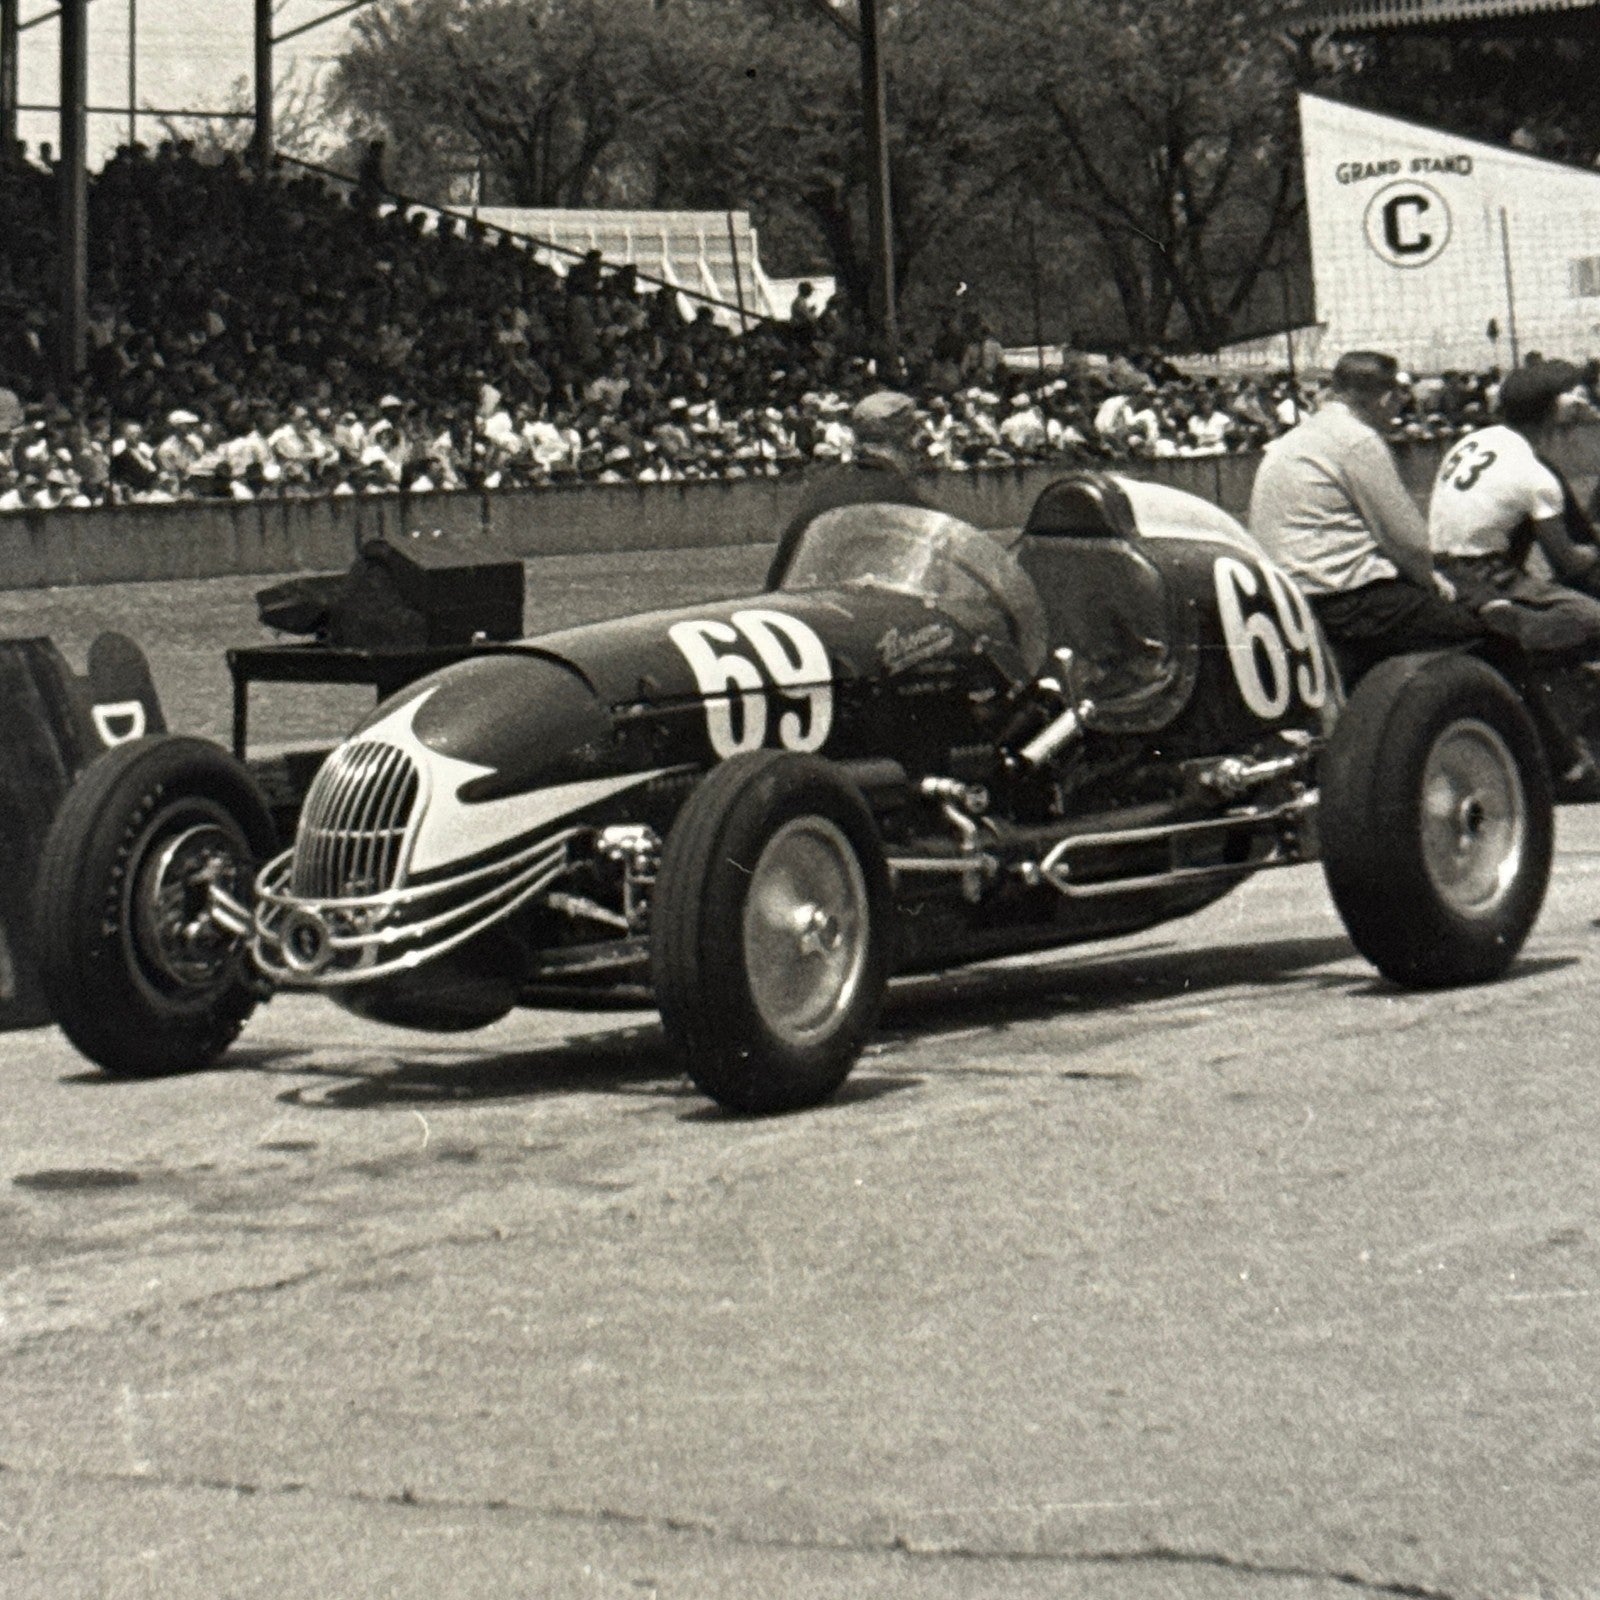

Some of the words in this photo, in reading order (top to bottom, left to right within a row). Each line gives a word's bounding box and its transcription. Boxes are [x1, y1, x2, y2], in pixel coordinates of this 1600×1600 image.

[1335, 159, 1401, 185] GRAND
[1410, 154, 1473, 176] STAND
[1383, 194, 1432, 255] C
[668, 610, 833, 760] 69
[1214, 557, 1325, 719] 69
